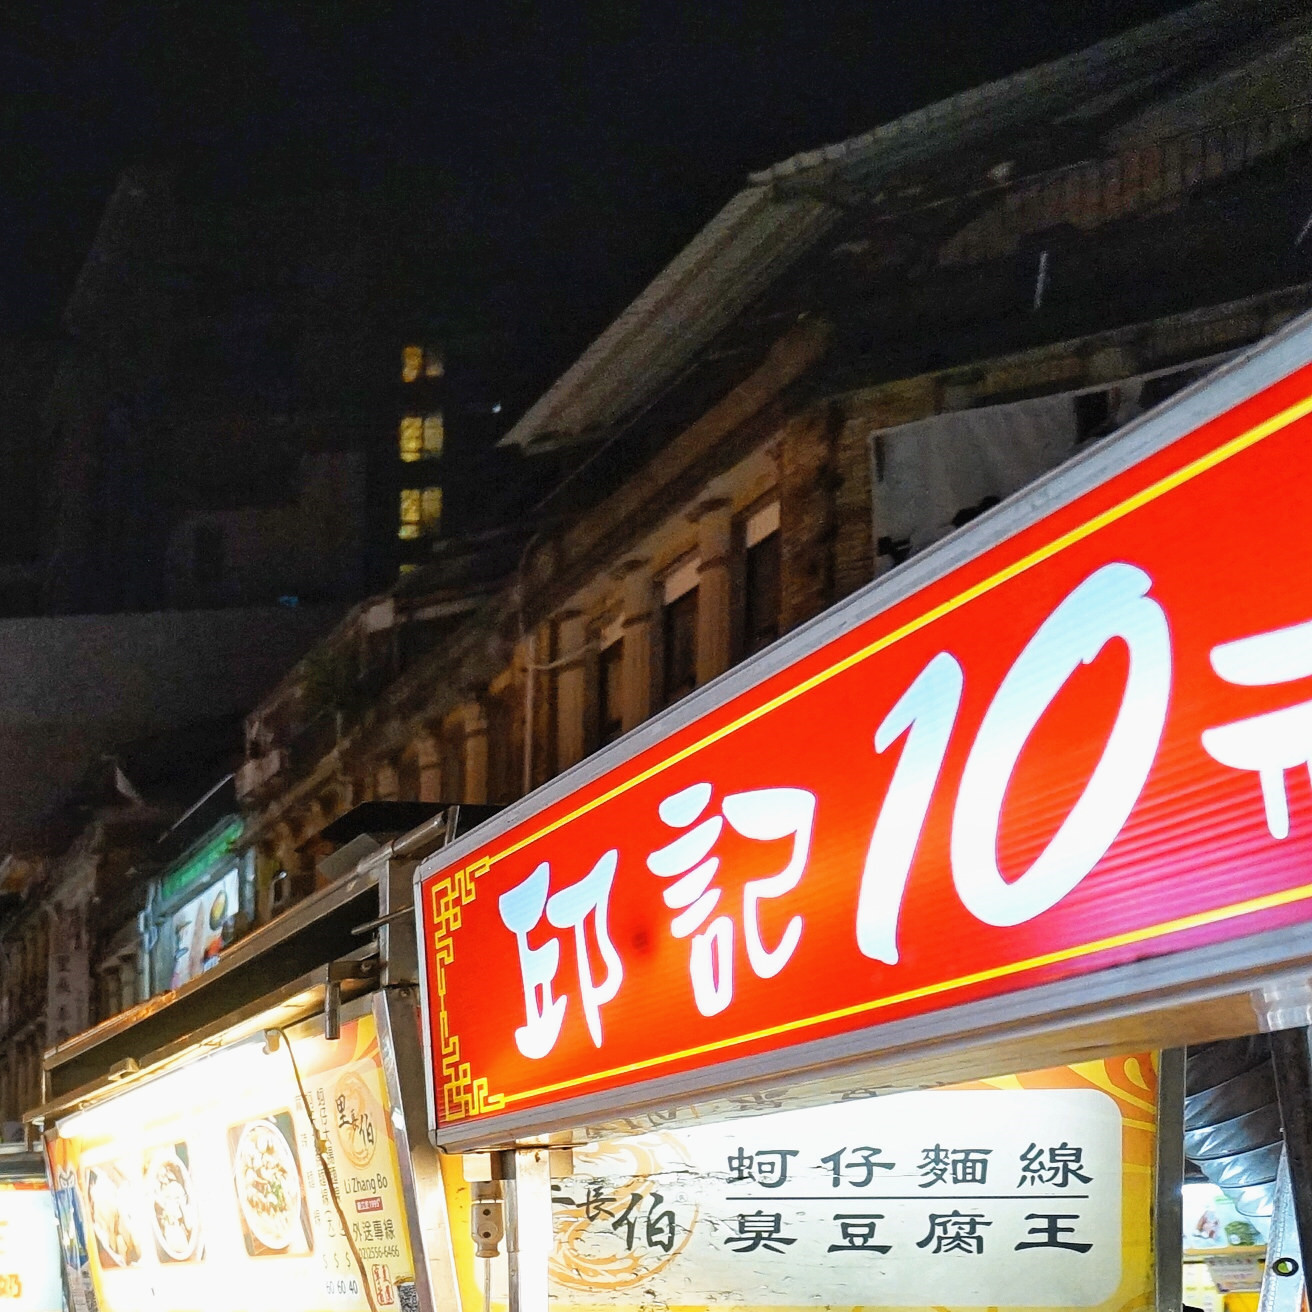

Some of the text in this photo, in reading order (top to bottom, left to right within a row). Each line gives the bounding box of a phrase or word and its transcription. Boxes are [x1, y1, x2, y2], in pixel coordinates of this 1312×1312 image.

[352, 1176, 376, 1195] Zhang
[376, 1173, 389, 1190] Bo
[726, 1141, 1095, 1189] 蚵仔麵線
[551, 1180, 676, 1253] 長伯
[723, 1210, 1095, 1256] 臭豆腐王
